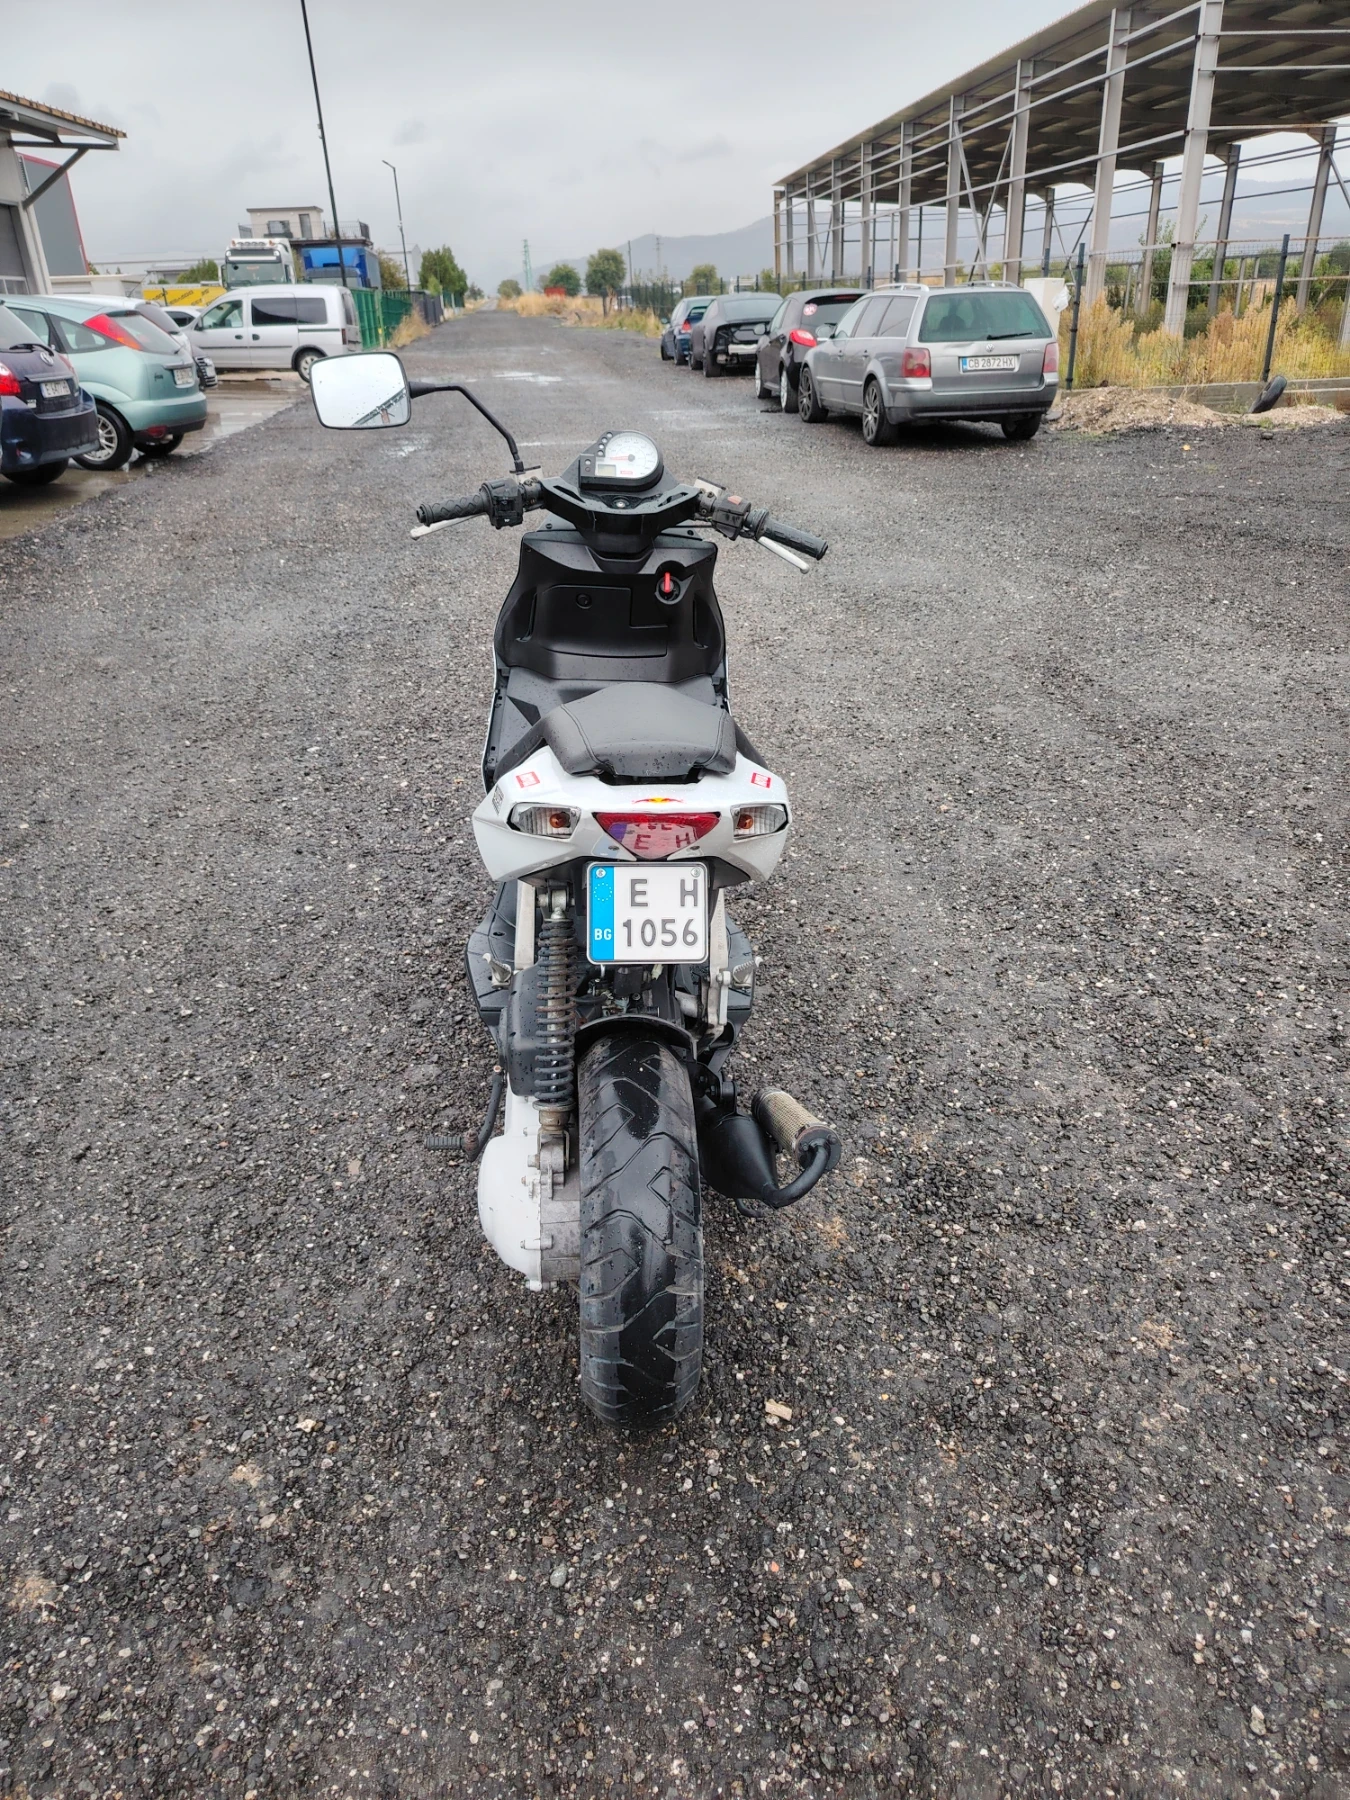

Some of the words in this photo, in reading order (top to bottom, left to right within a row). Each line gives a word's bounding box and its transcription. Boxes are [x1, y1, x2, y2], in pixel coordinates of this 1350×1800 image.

[968, 359, 980, 369] CB
[982, 358, 1001, 368] 2872
[1002, 357, 1014, 368] HX
[630, 878, 649, 907] E
[680, 878, 698, 907] H
[594, 928, 612, 941] BG
[622, 918, 698, 947] 1056
